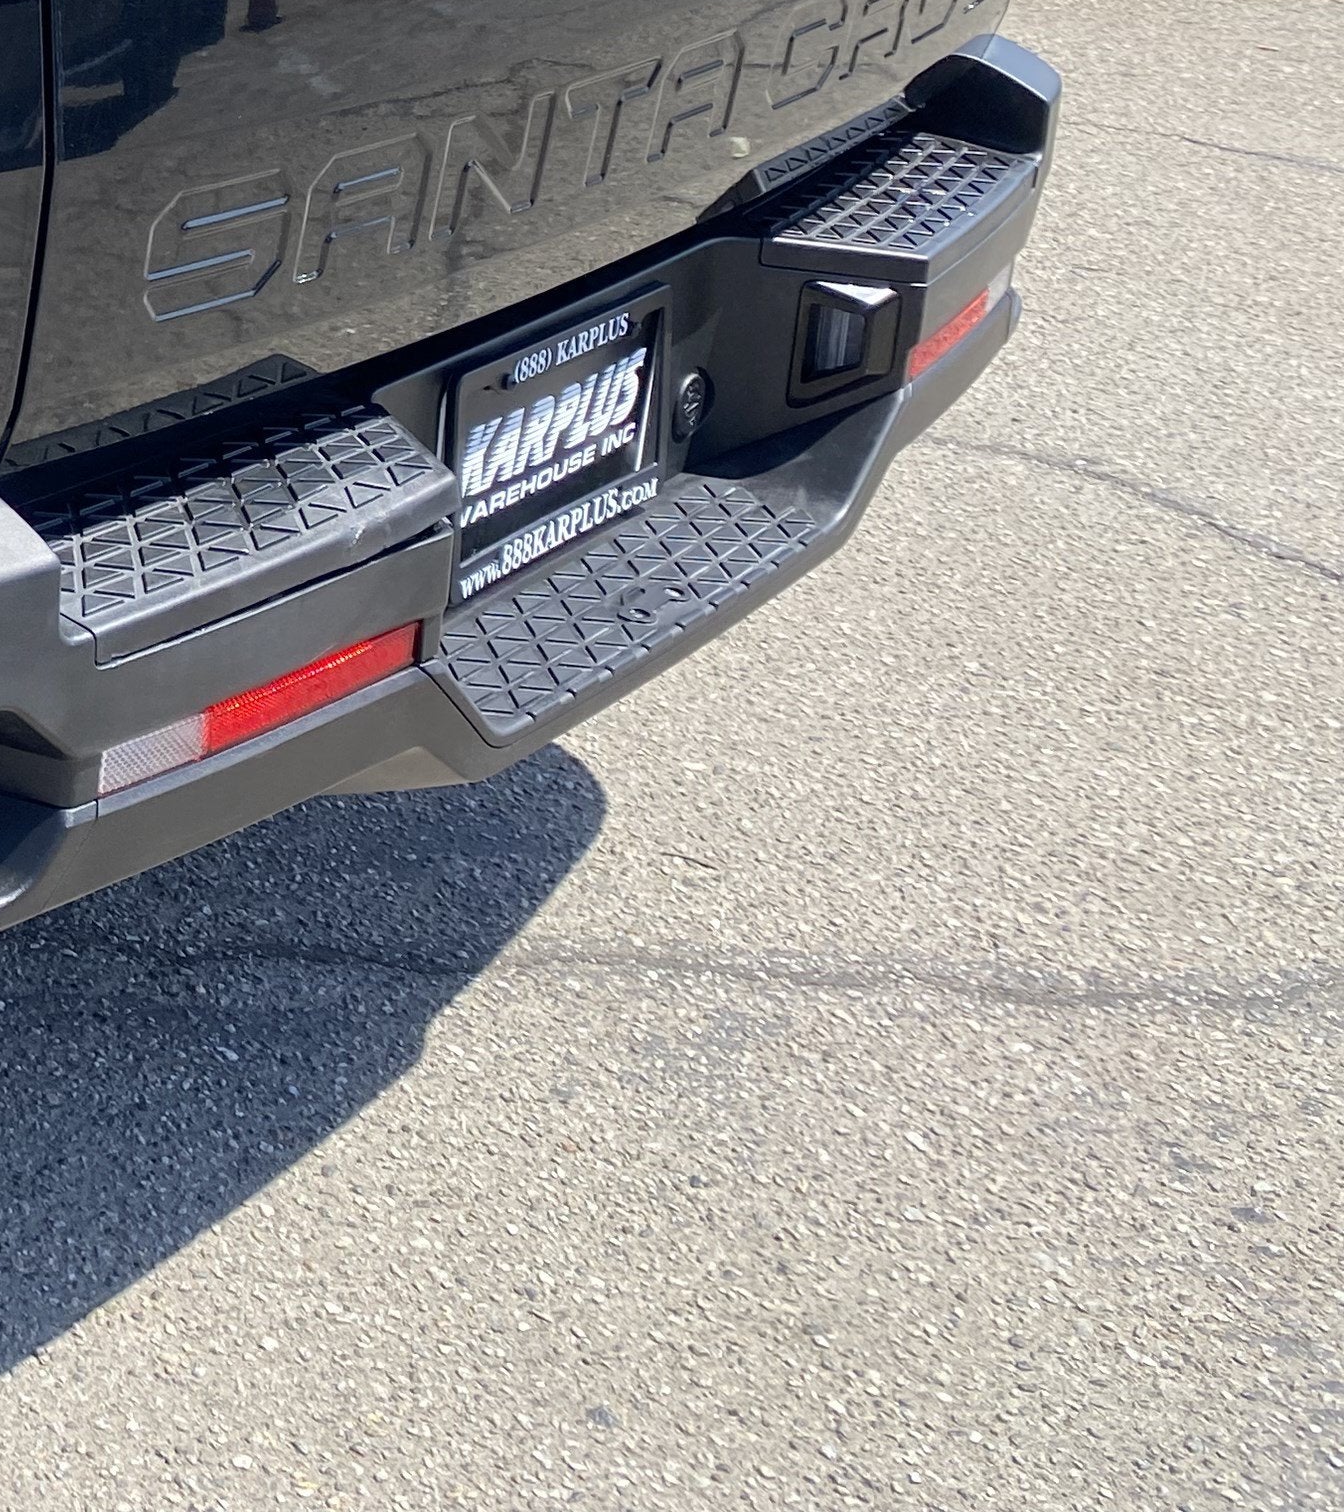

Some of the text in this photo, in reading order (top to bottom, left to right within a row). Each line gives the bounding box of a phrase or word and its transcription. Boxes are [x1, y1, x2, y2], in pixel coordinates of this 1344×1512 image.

[143, 28, 745, 324] SANTA
[513, 311, 631, 384] (888) KARPLUS
[461, 346, 648, 499] KARPLUS
[601, 422, 637, 457] INC
